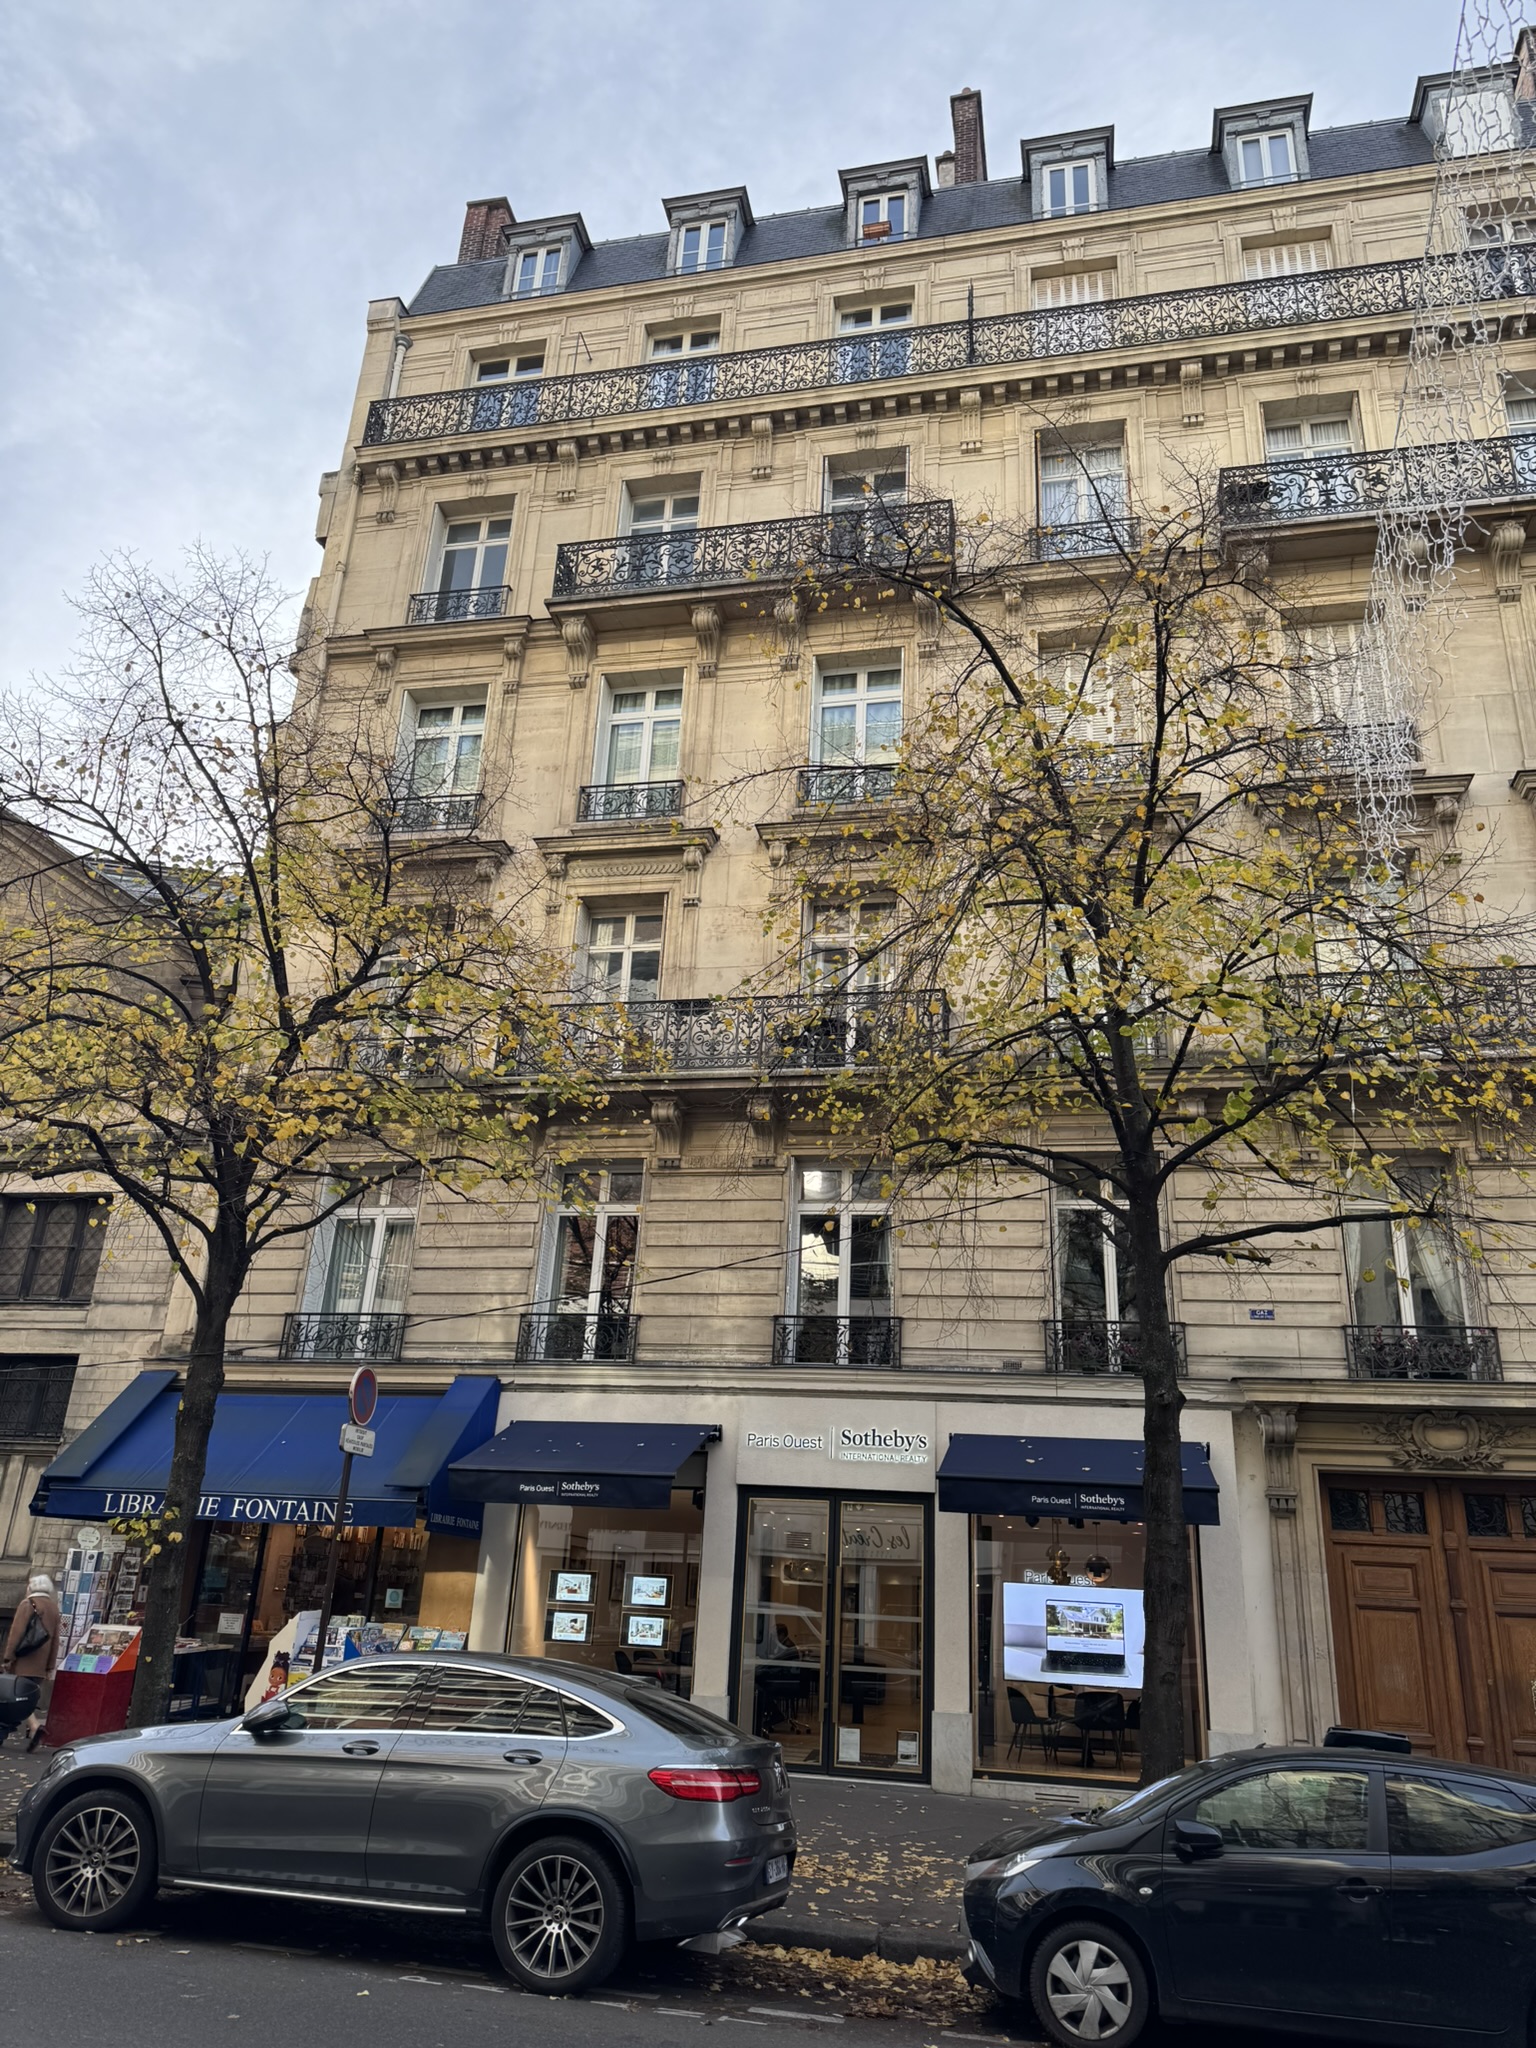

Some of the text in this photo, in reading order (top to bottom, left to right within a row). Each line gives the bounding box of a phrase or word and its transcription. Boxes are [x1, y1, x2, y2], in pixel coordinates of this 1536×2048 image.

[747, 1433, 823, 1450] Paris Ouest
[840, 1427, 928, 1452] Sotheby's
[839, 1452, 928, 1464] INTERNATIONAL REALTY
[519, 1484, 555, 1492] Paris Ouest
[561, 1481, 600, 1493] Sotheby's
[1031, 1495, 1072, 1505] Paris Ouest
[1080, 1493, 1125, 1507] Sotheby's
[230, 1497, 354, 1524] FONTAINE
